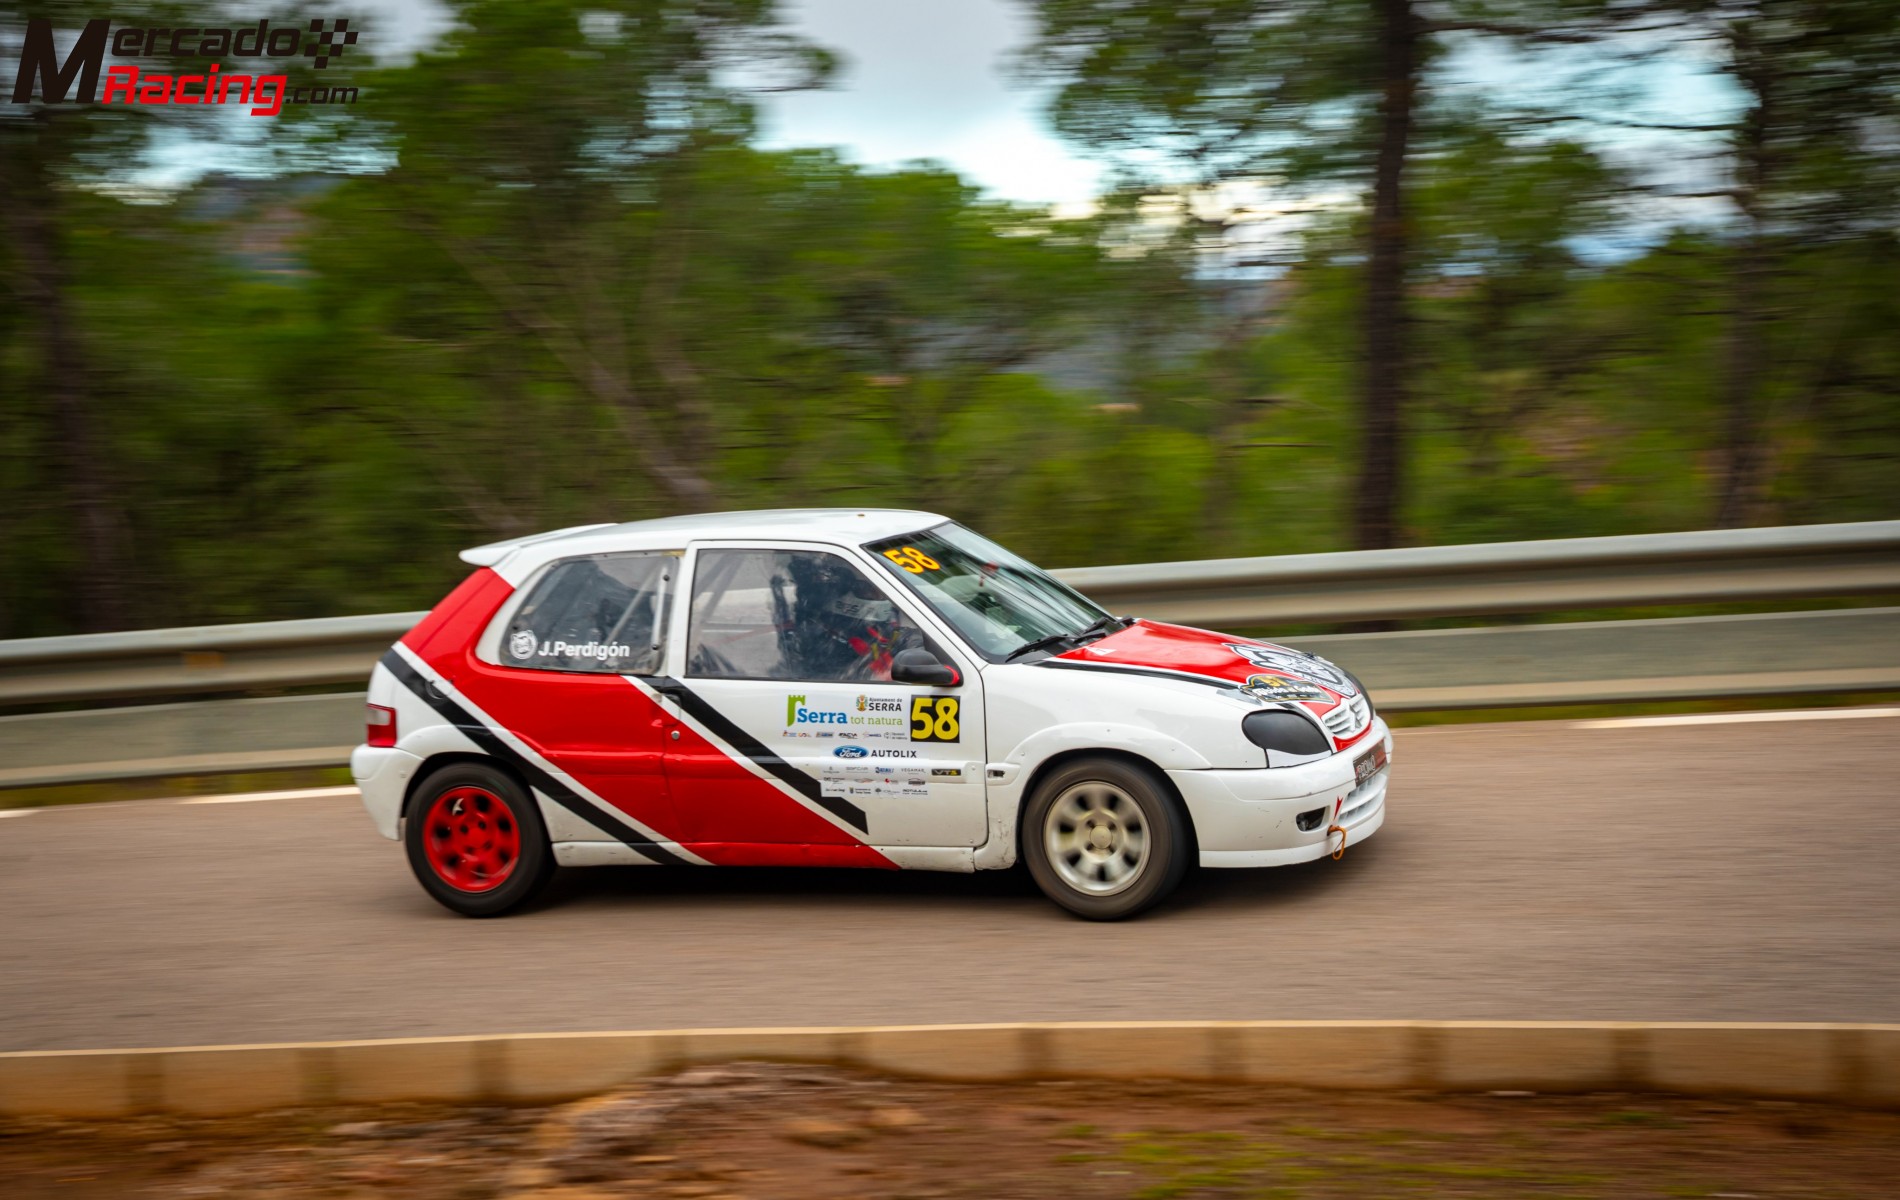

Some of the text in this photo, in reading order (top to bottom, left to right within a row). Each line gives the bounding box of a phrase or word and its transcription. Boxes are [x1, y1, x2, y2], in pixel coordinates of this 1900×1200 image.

[883, 546, 941, 574] 58
[538, 641, 630, 660] J.Perdigón
[869, 703, 902, 711] SERRA
[797, 708, 903, 726] Serra tot natura
[911, 697, 959, 740] 58
[839, 748, 862, 758] Ford
[871, 750, 917, 758] AUTOLIX
